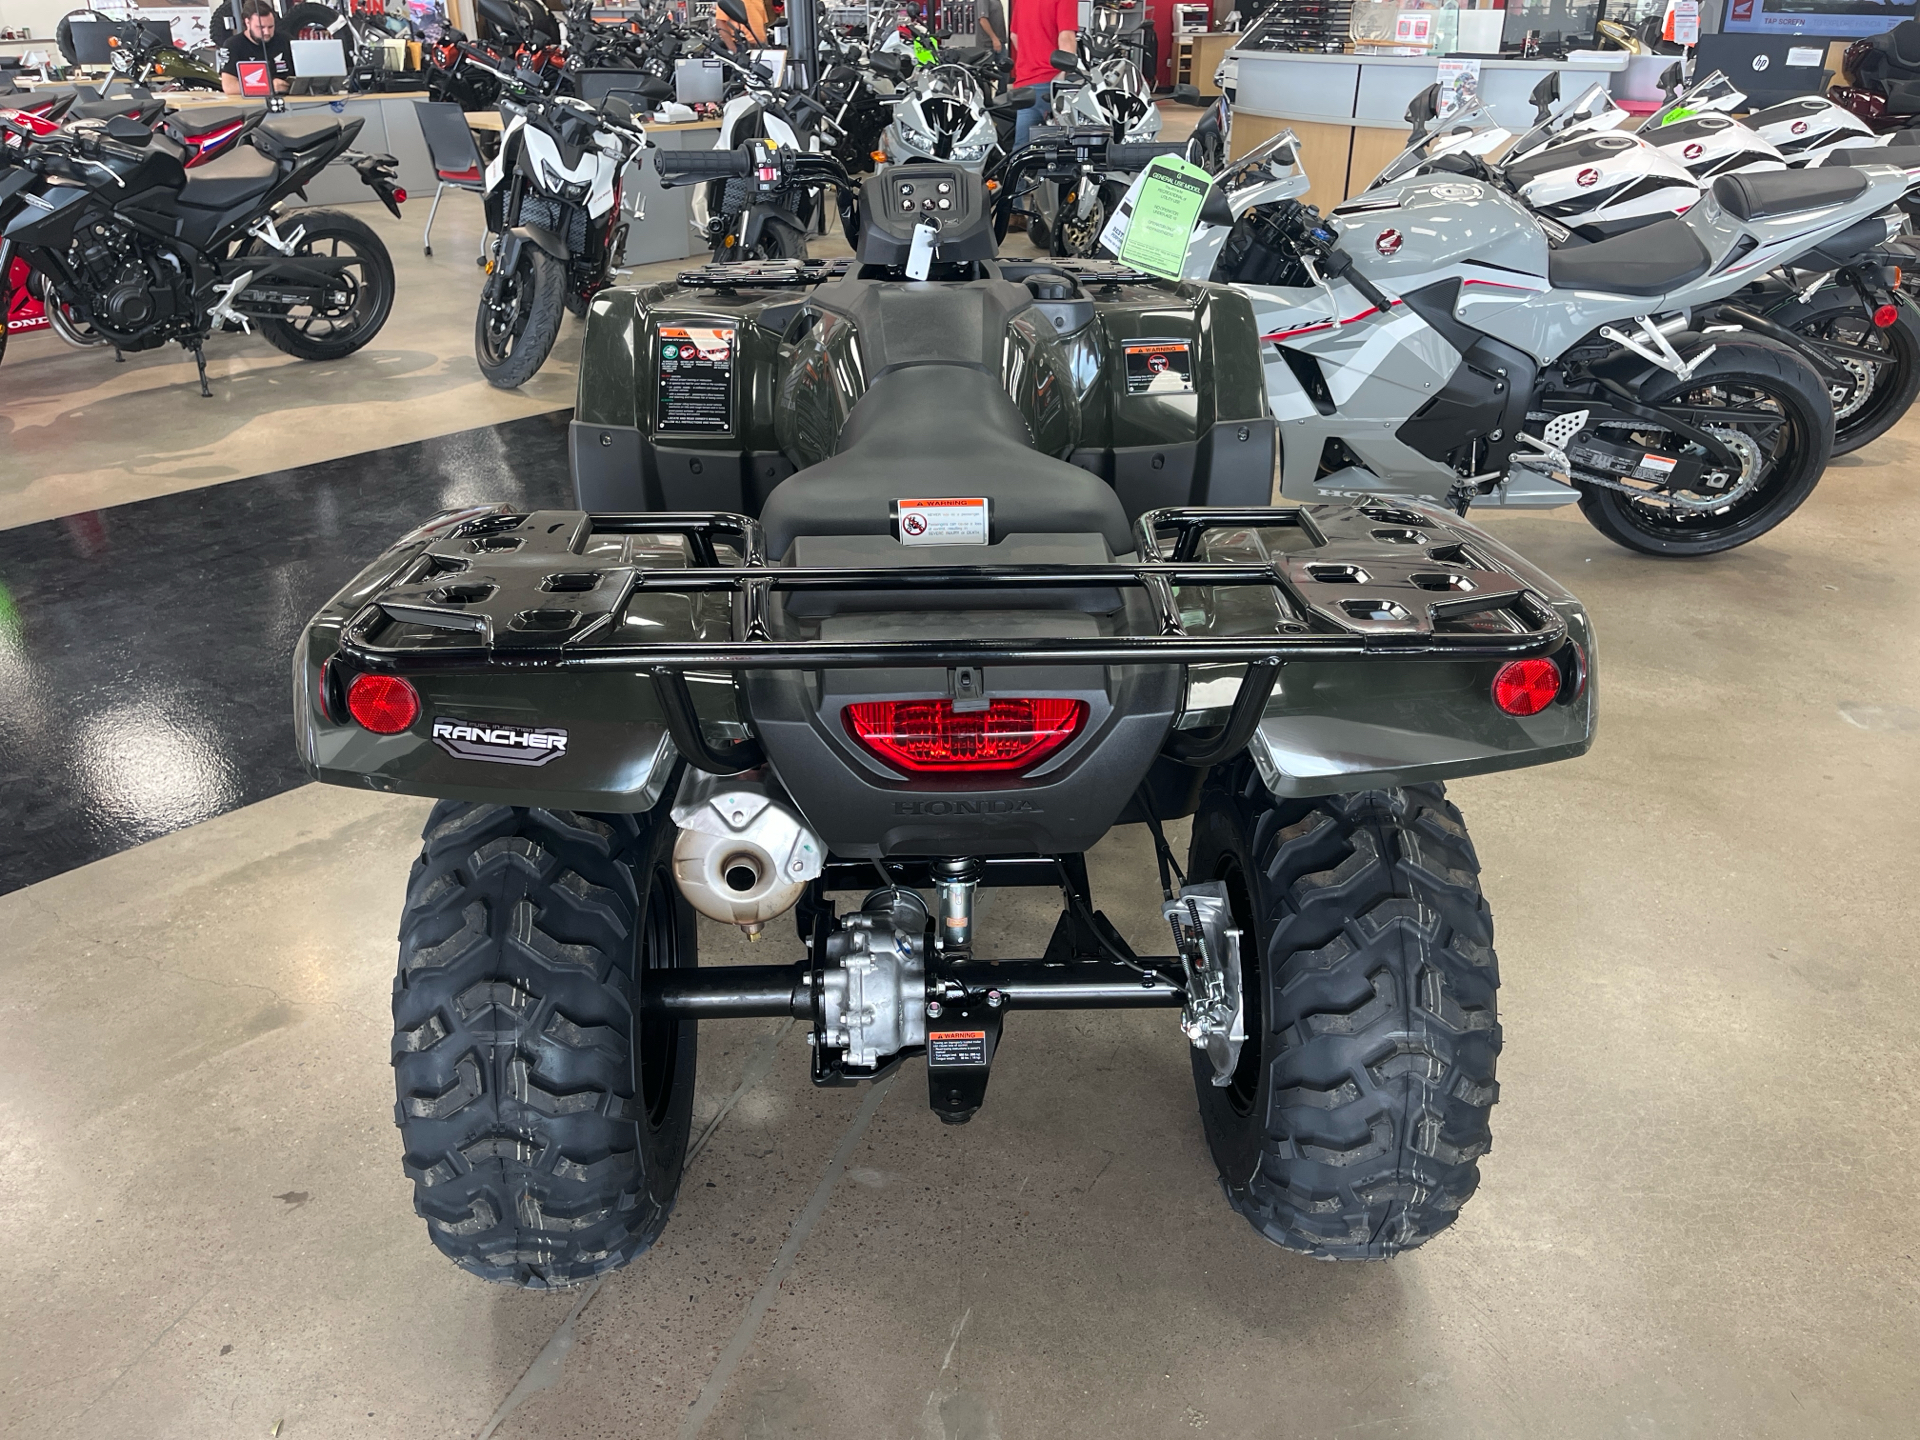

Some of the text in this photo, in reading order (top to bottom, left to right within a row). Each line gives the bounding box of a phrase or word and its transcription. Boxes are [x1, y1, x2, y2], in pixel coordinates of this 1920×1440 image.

[1152, 172, 1200, 193] GENERAL USE MODEL
[8, 317, 49, 328] OND
[492, 724, 533, 732] INJECTION
[433, 724, 567, 750] RANCHER
[892, 800, 1044, 816] HONDA
